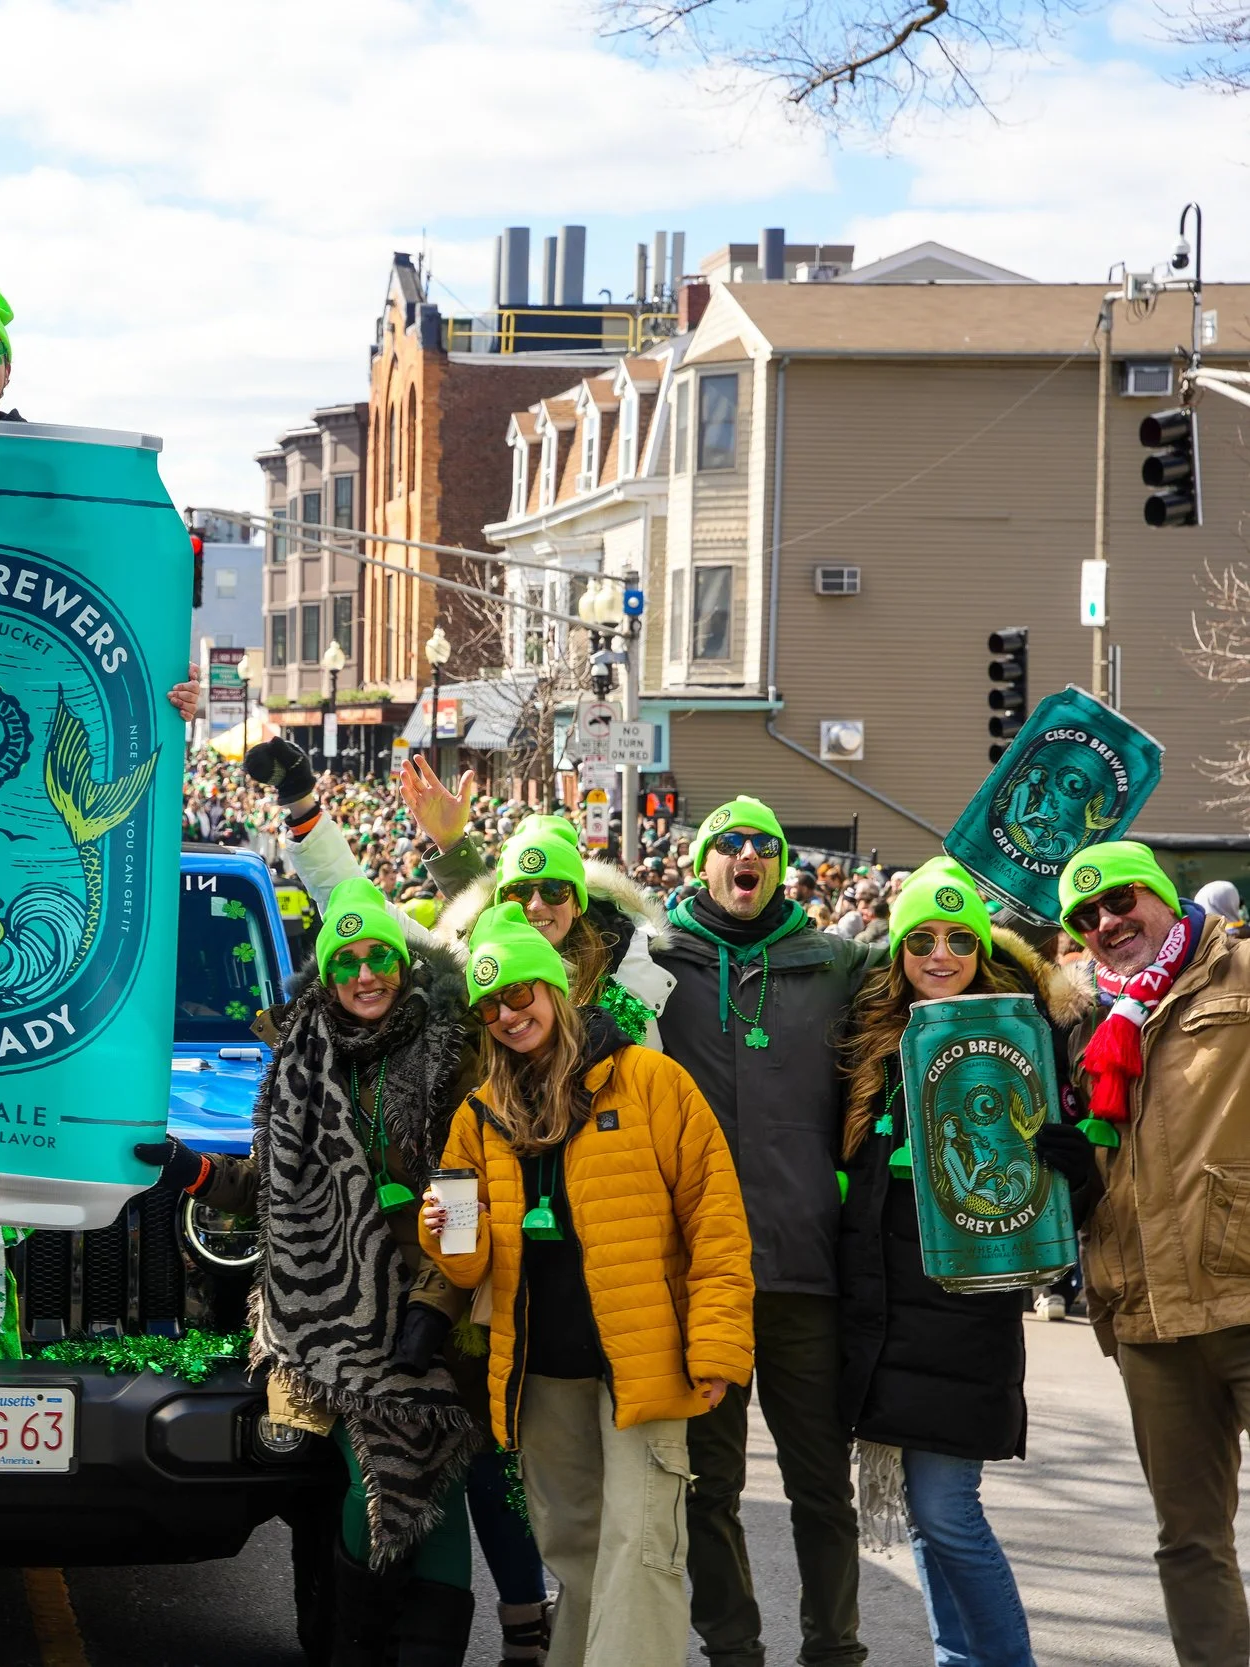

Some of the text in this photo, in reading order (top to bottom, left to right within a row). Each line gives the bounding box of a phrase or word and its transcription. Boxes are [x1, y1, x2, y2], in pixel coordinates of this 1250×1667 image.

[129, 724, 138, 758] NICE
[618, 738, 644, 747] TURN
[622, 726, 640, 736] NO
[611, 751, 625, 760] ON
[629, 751, 649, 760] RED
[1045, 729, 1088, 743] CISCO
[1089, 738, 1129, 792] BREWERS
[992, 827, 1059, 876] GREY LADY
[120, 820, 135, 933] YOU CAN GET IT
[928, 1040, 1032, 1083] CISCO BREWERS
[955, 1204, 1036, 1234] GREY LADY
[966, 1243, 1007, 1255] WHEAT
[20, 1411, 63, 1451] 63
[0, 1456, 34, 1465] America
